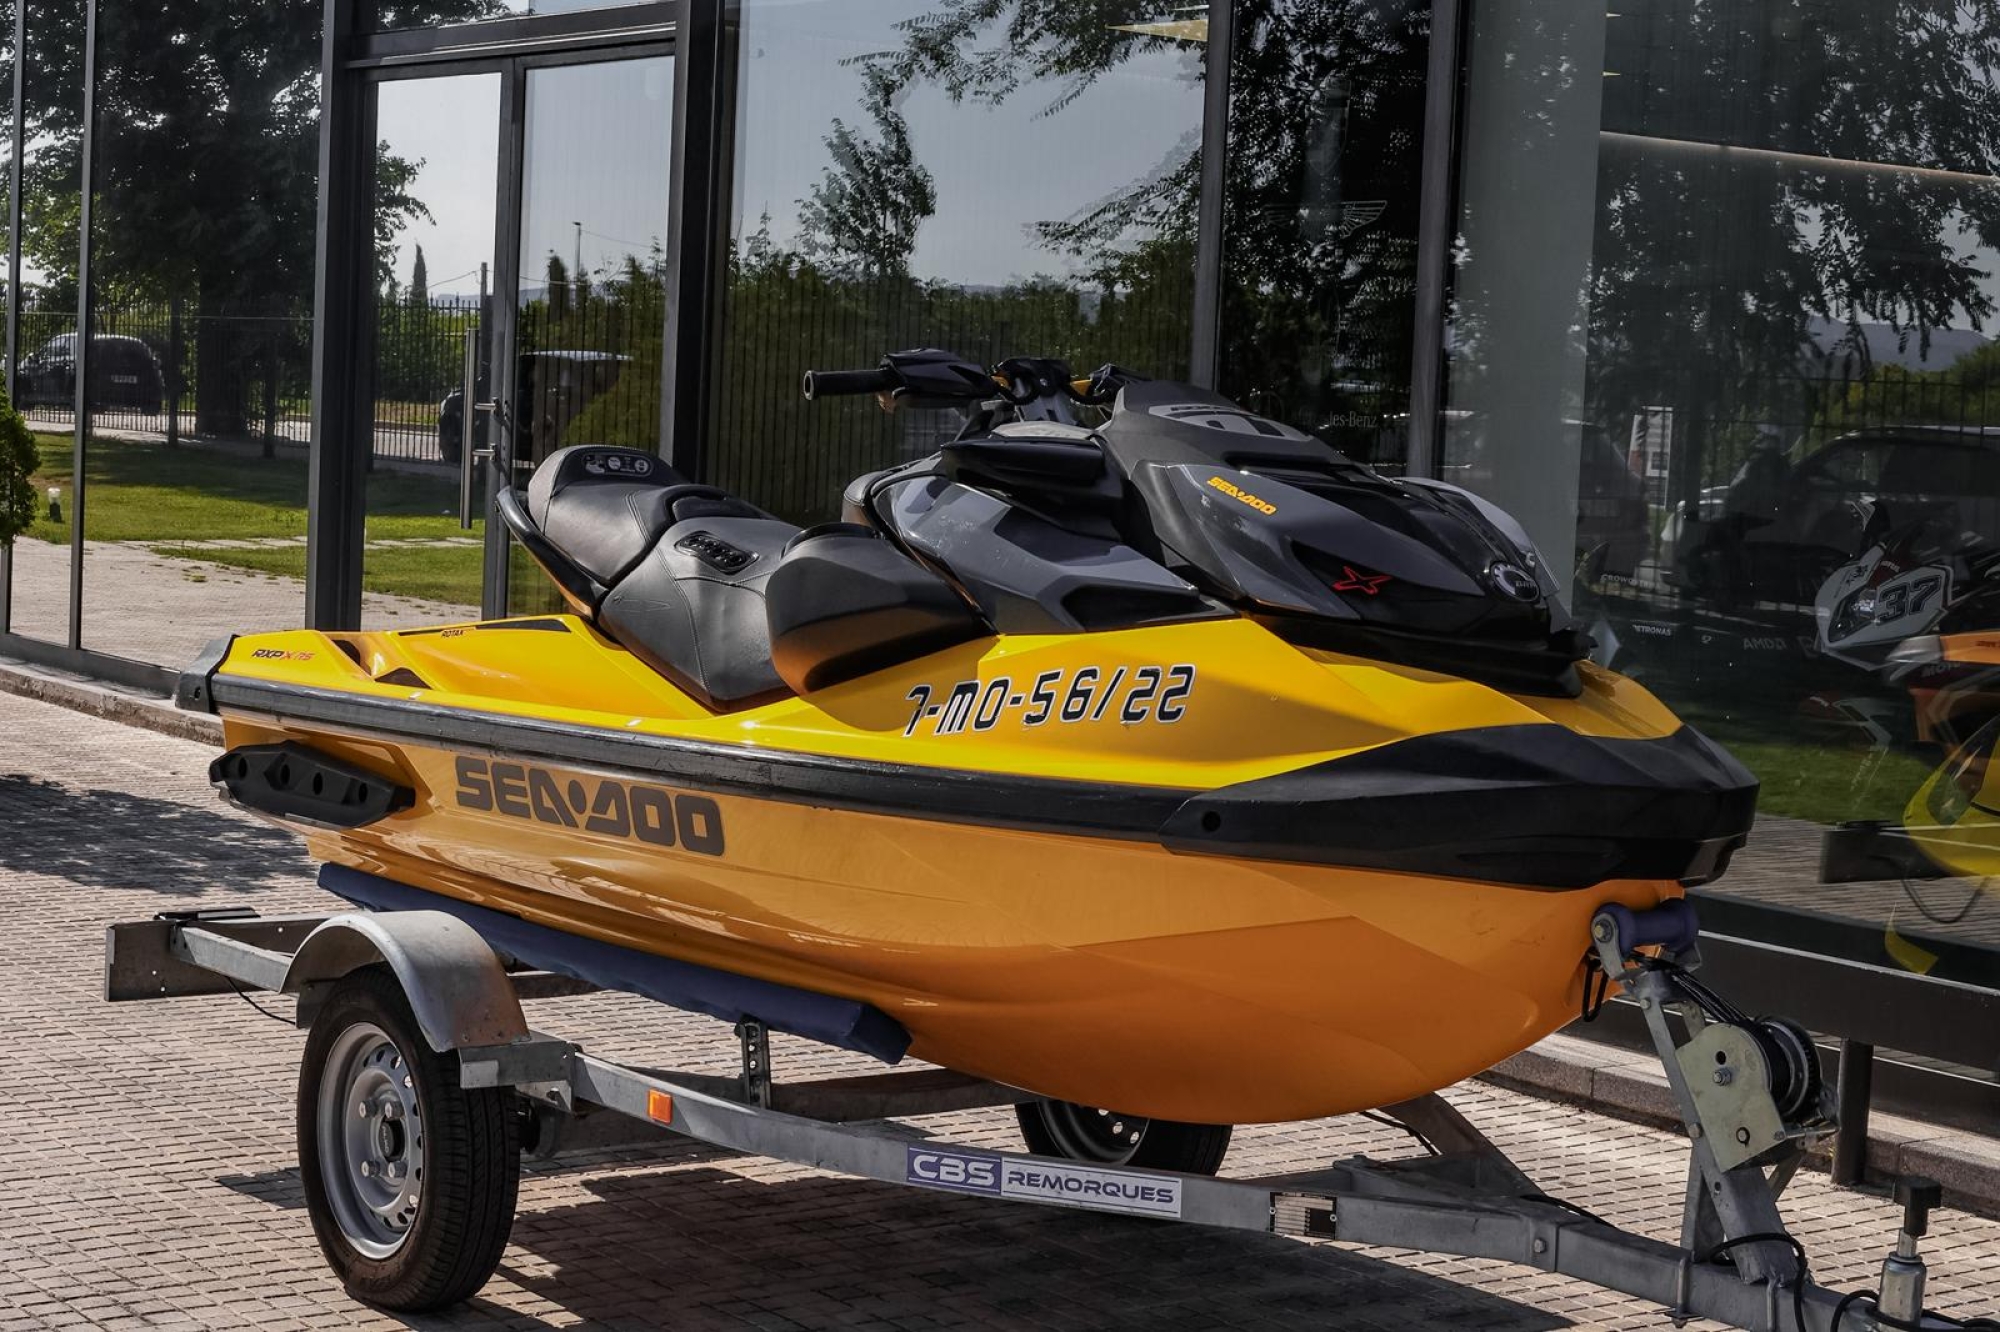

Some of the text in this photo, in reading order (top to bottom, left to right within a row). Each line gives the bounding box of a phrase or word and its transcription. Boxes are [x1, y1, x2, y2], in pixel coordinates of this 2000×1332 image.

[1878, 574, 1942, 622] 37
[913, 1154, 1174, 1204] CBS REMORQUES
